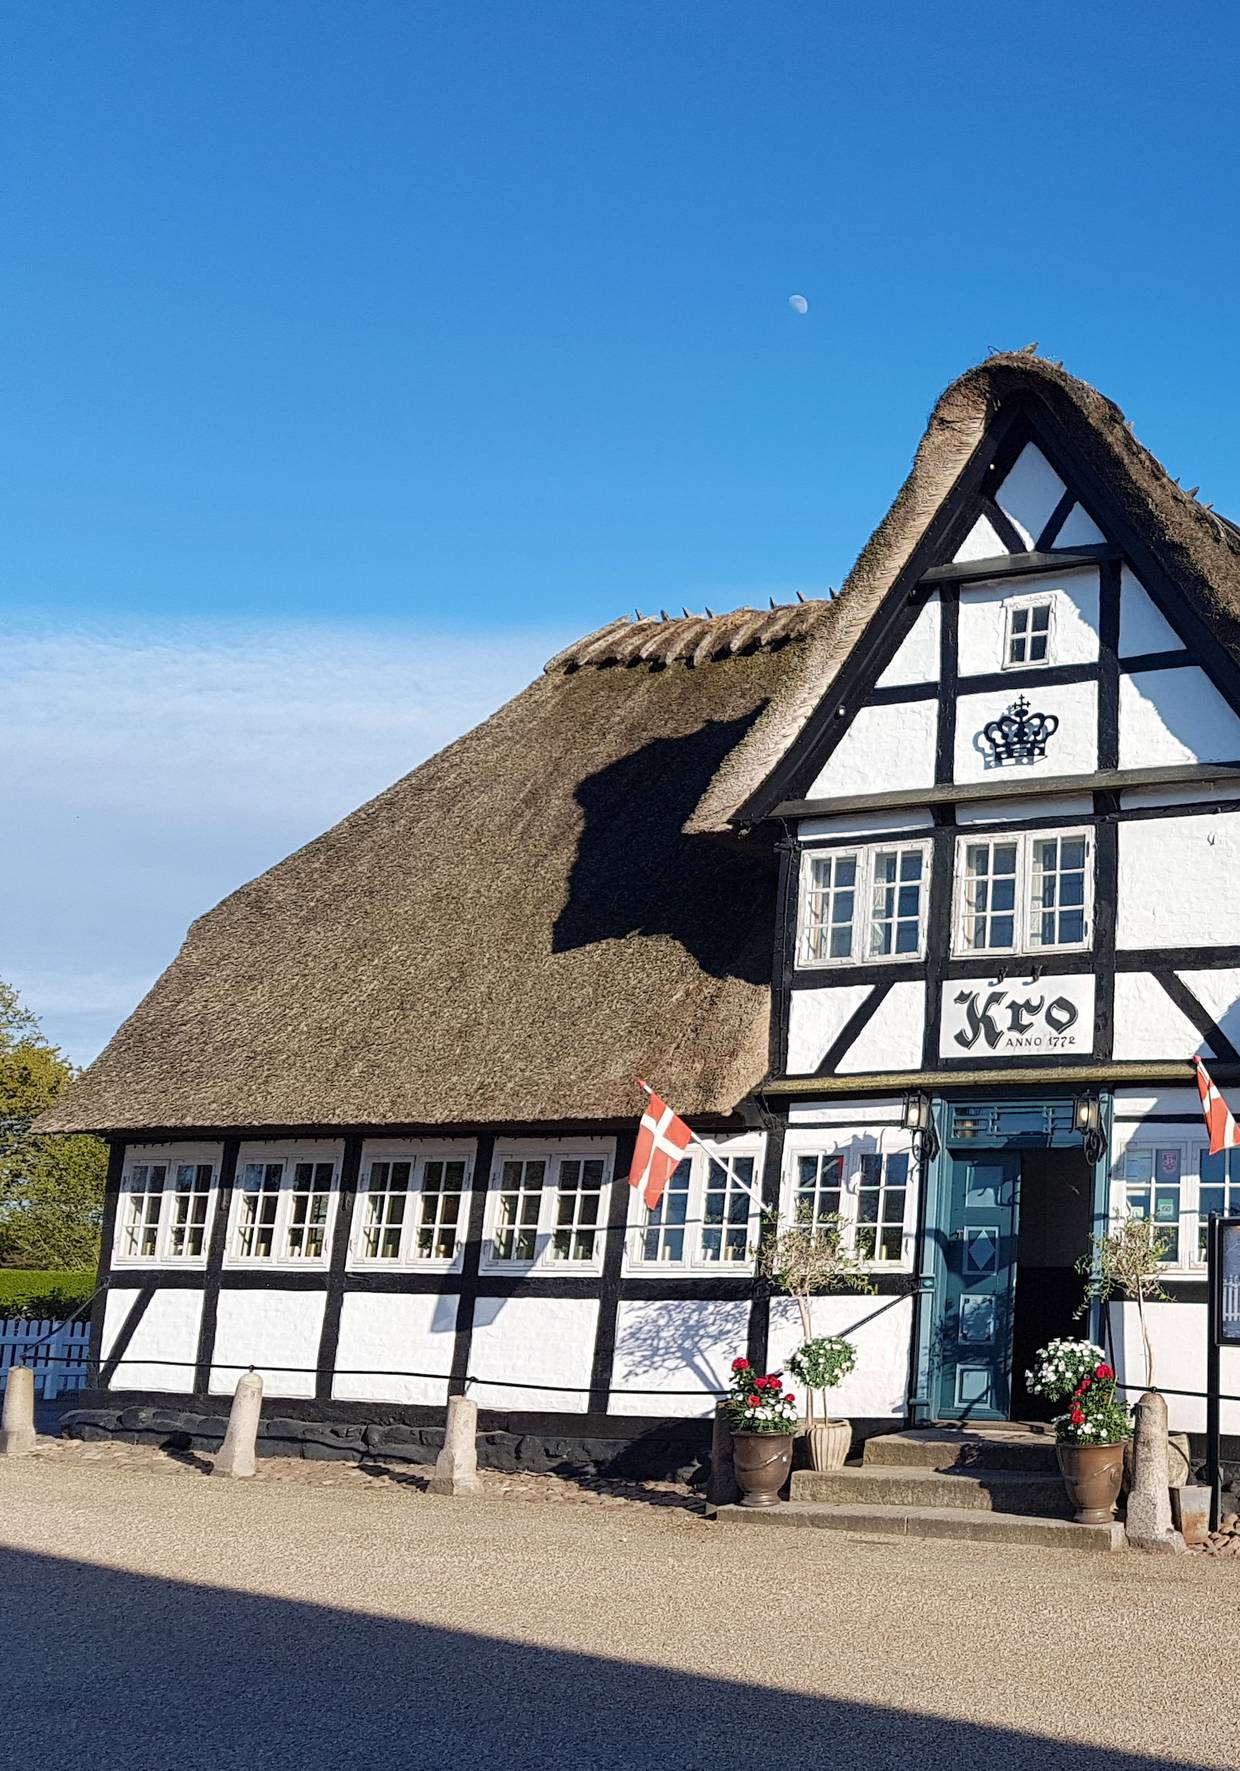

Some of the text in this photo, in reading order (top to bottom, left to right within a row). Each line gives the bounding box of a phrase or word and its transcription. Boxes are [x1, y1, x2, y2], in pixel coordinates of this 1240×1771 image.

[953, 990, 1079, 1050] Kro
[1006, 1035, 1076, 1048] ANNO 1772
